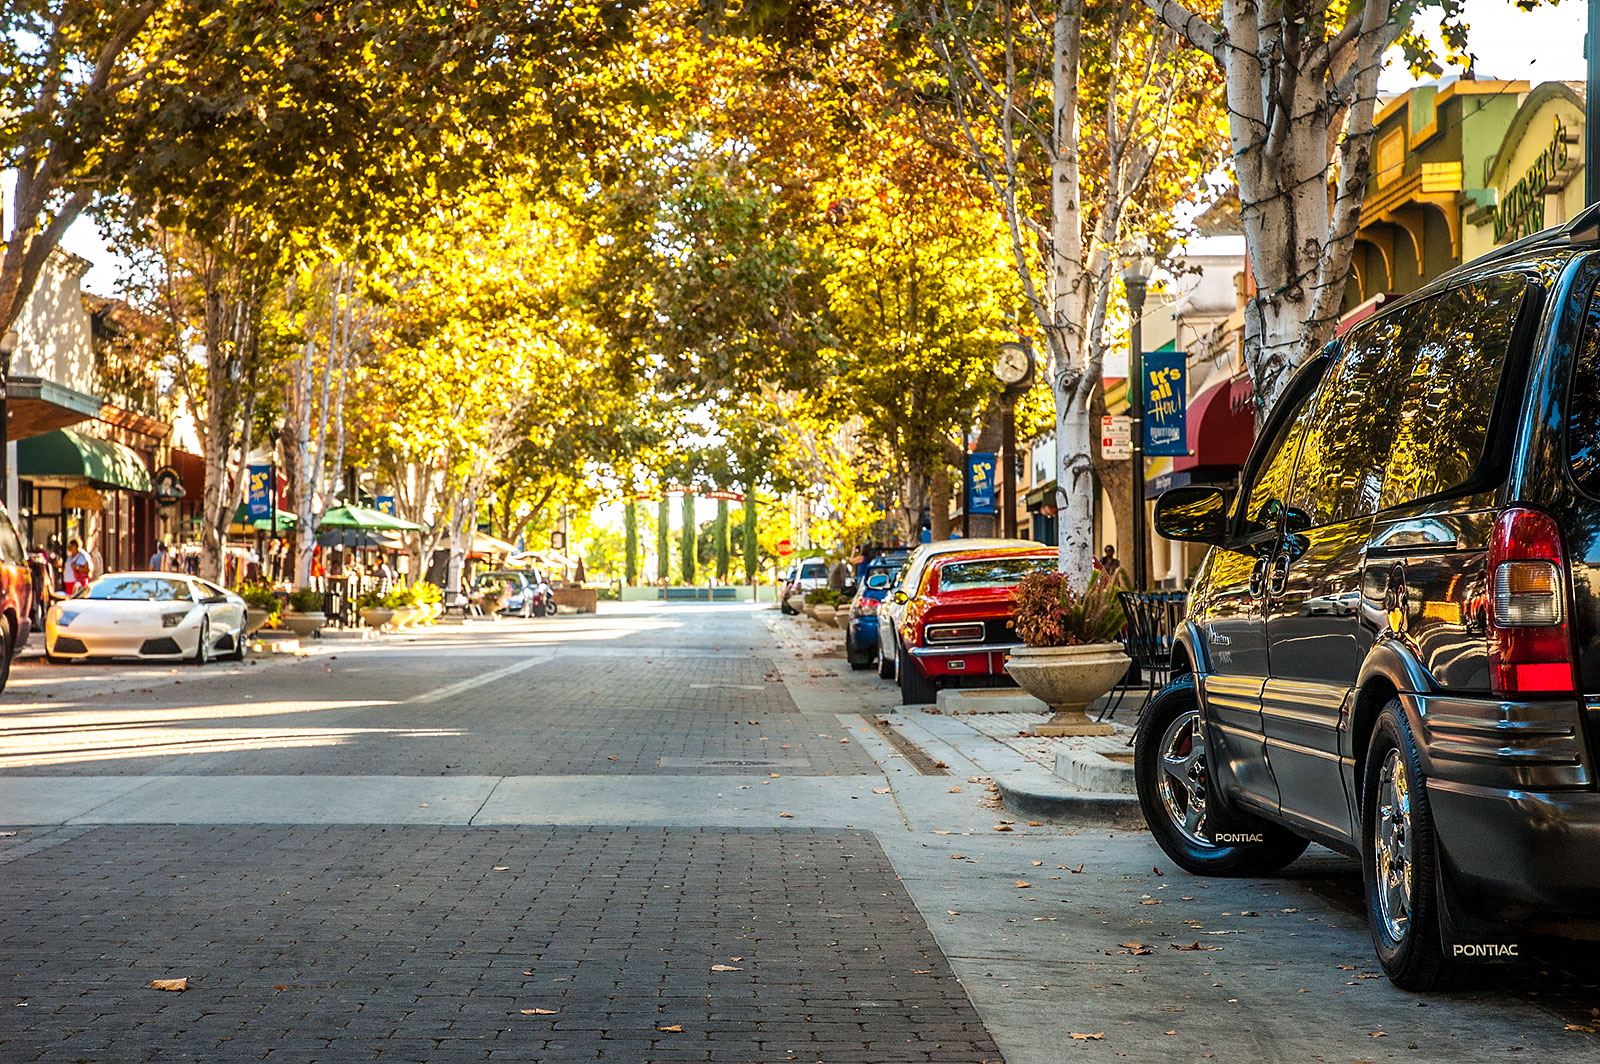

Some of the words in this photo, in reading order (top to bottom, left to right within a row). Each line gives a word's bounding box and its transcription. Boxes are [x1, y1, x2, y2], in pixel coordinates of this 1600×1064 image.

[1493, 113, 1567, 245] MURPHY'S
[1149, 367, 1181, 386] It's
[1150, 382, 1172, 402] all
[1147, 387, 1182, 425] Here!
[1215, 833, 1264, 842] PONTIAC
[1453, 944, 1519, 956] PONTIAC
